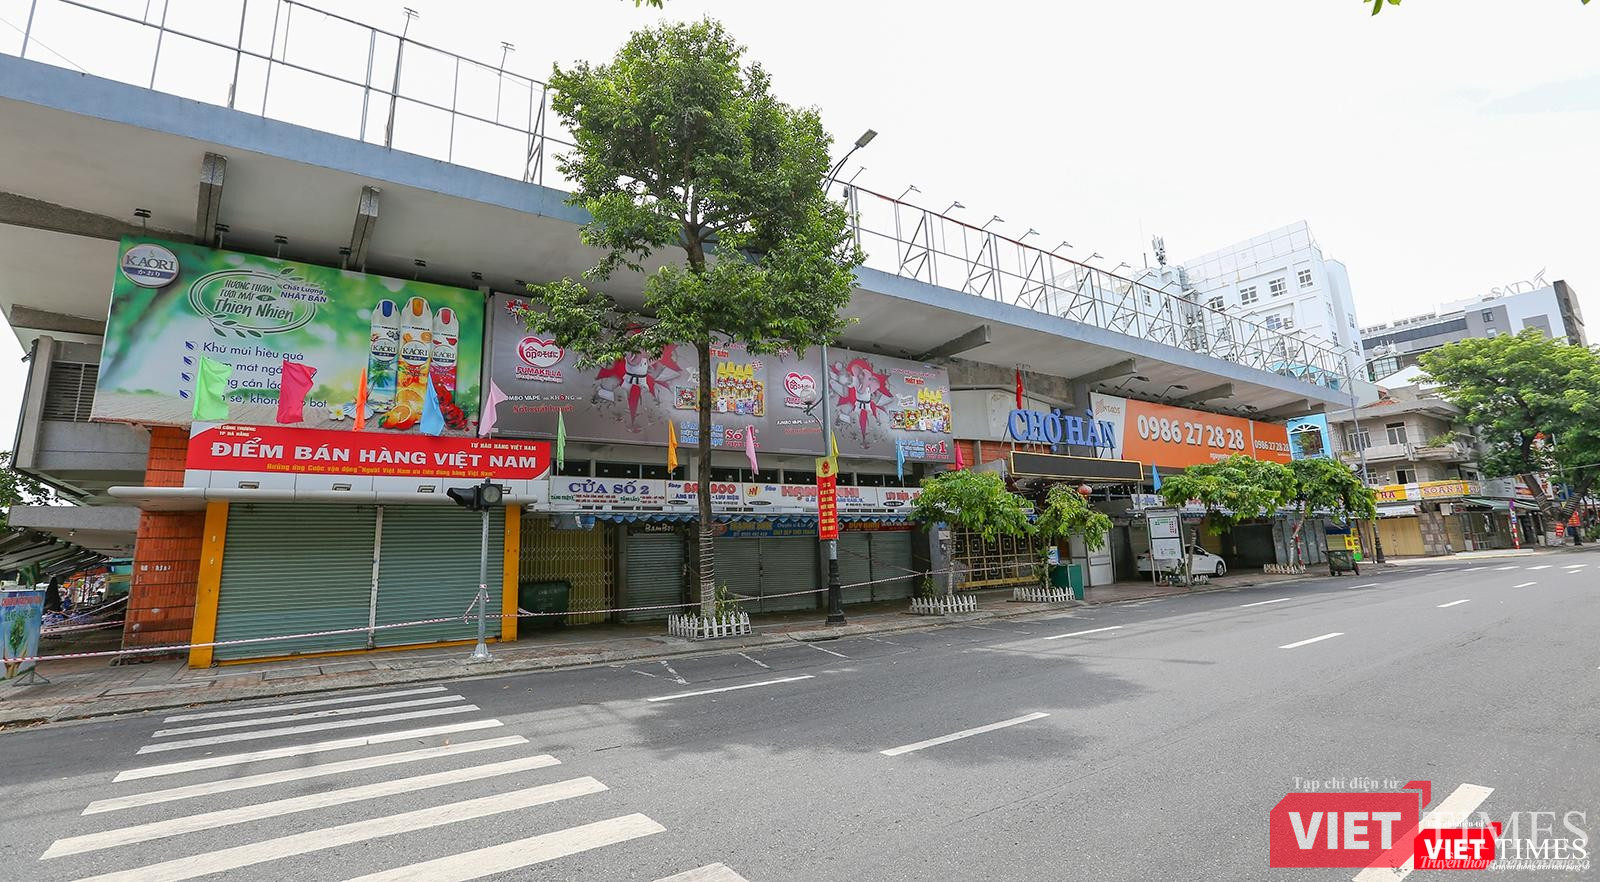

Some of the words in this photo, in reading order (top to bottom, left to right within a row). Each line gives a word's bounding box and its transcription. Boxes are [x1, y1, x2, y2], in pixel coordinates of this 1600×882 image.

[125, 255, 175, 271] KAORI
[402, 348, 428, 356] KAORI
[434, 351, 455, 359] KAORI
[516, 367, 562, 377] FUMAKILLA
[1009, 409, 1062, 451] CHỢ
[1064, 409, 1116, 448] HÀN
[1137, 415, 1182, 443] 0986
[1184, 422, 1203, 445] 27
[1206, 425, 1225, 448] 28
[1226, 428, 1245, 450] 28
[211, 437, 284, 459] ĐIỂM
[294, 444, 350, 463] BÁN
[359, 446, 426, 465] HÀNG
[433, 450, 482, 469] VIỆT
[489, 455, 536, 469] NAM
[568, 479, 608, 494] CỬA
[613, 480, 637, 495] SỐ
[640, 485, 650, 495] 2
